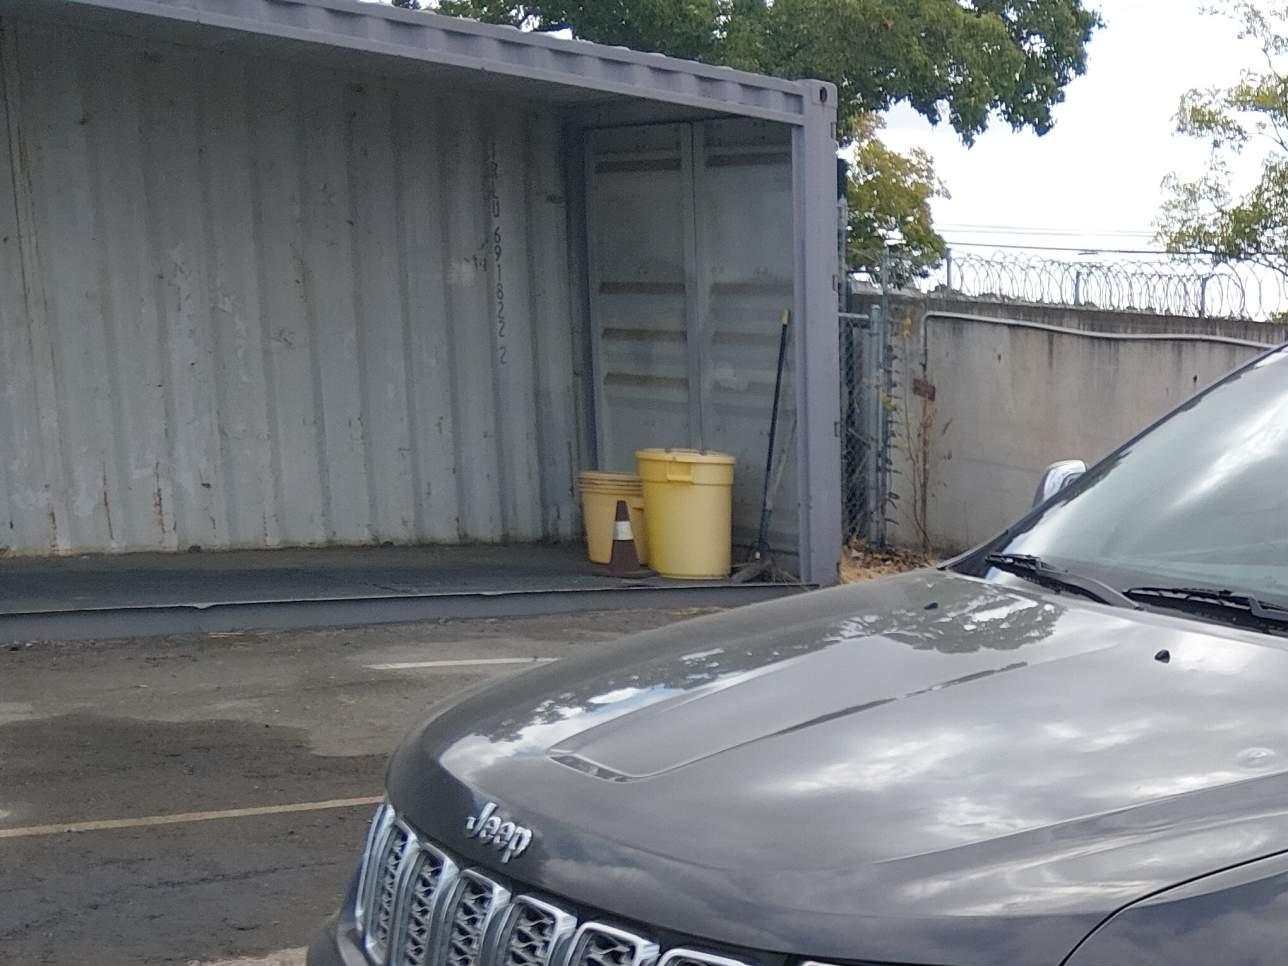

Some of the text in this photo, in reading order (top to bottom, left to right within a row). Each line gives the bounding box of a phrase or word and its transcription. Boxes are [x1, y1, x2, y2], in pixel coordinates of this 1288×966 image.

[493, 226, 506, 338] 691822
[498, 346, 508, 366] 2
[465, 801, 533, 864] Jeep
